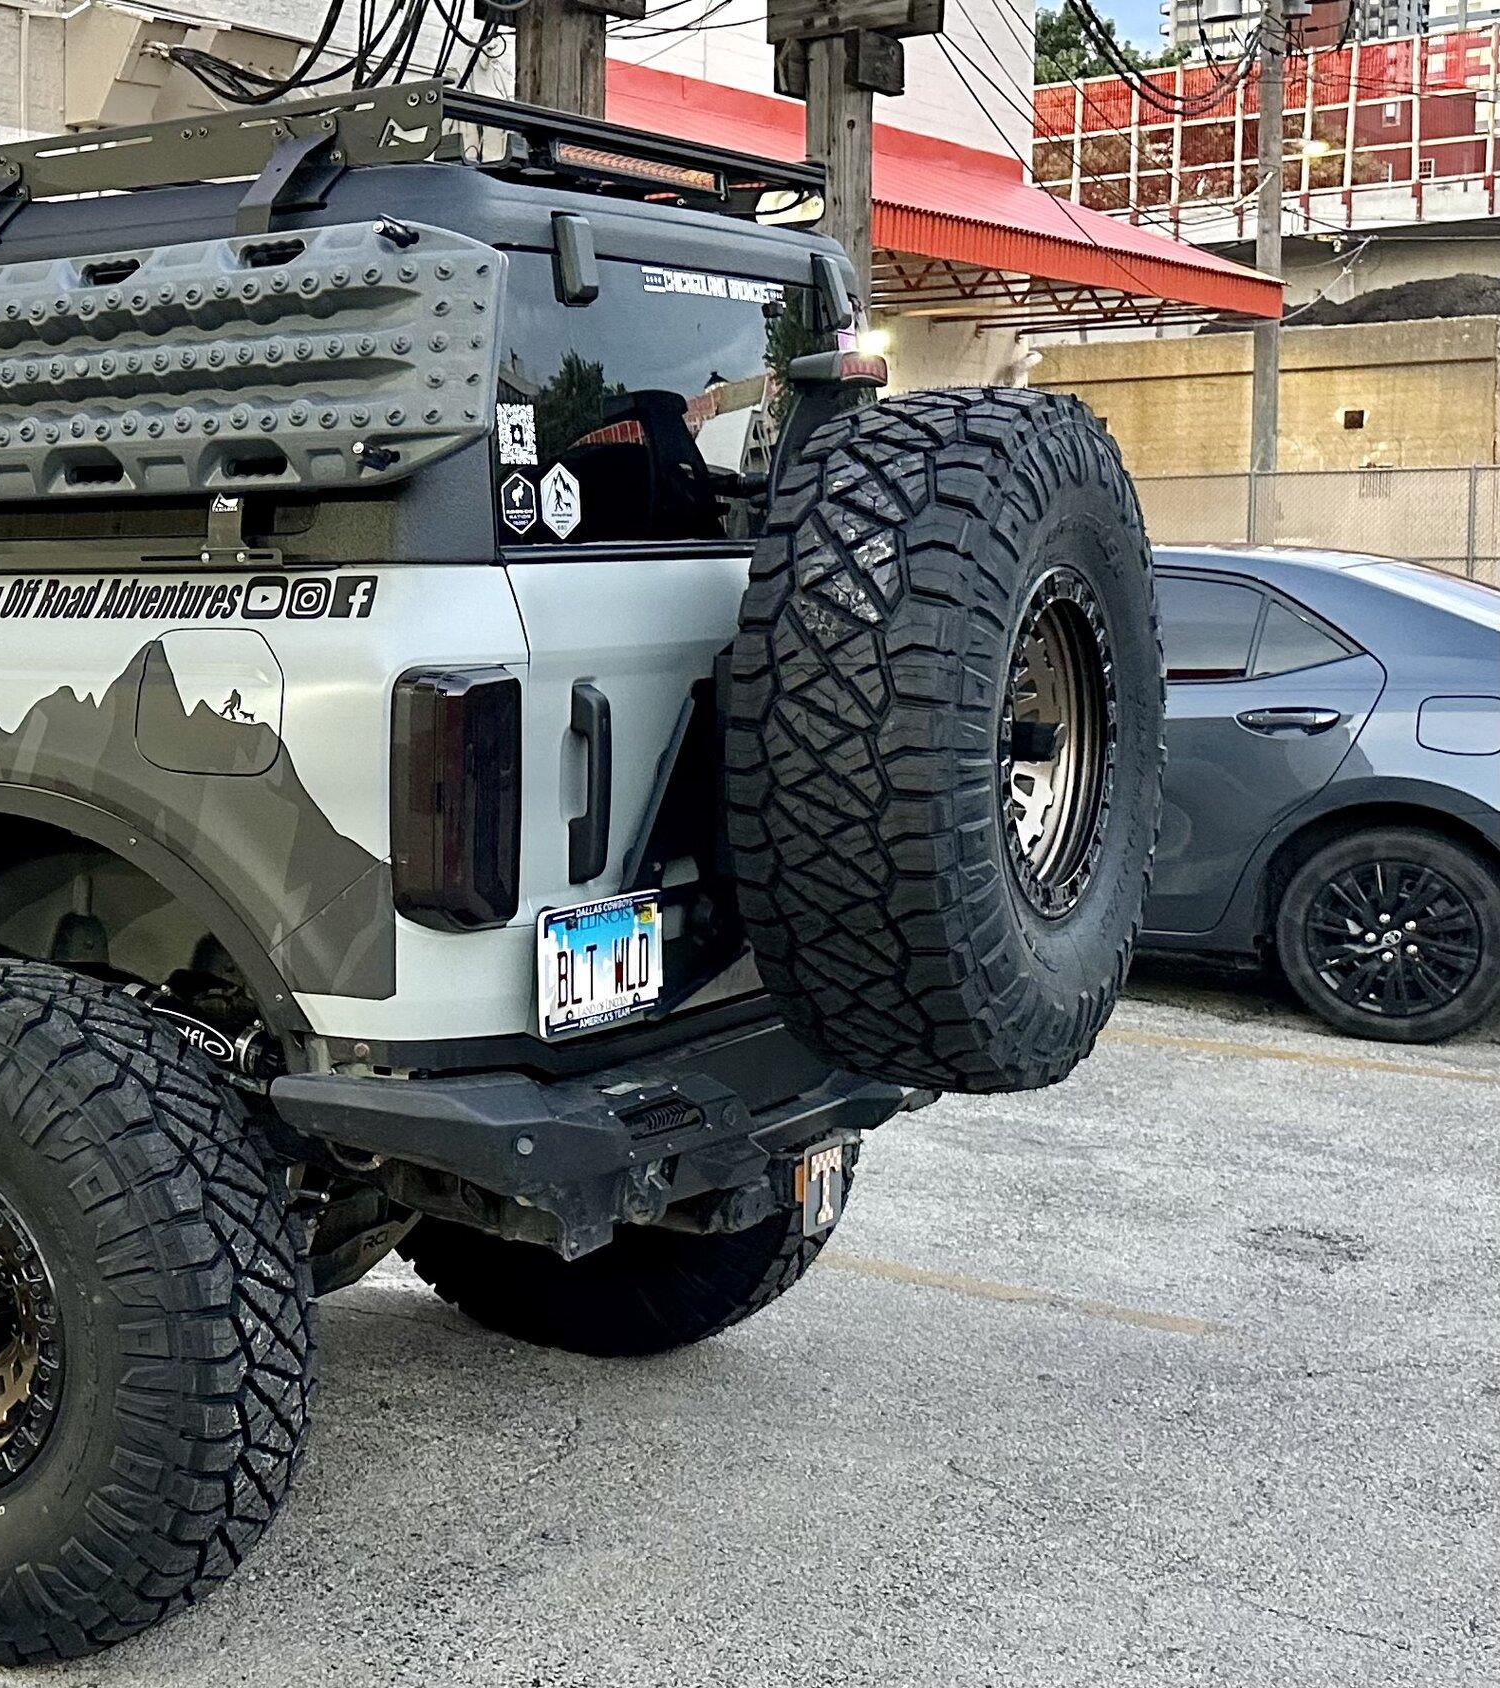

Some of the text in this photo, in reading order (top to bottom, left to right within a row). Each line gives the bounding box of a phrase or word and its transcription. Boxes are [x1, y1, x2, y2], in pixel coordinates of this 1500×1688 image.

[0, 578, 43, 619] Off
[33, 578, 104, 619] Road
[94, 578, 243, 619] Adventures
[575, 898, 634, 918] DALLAS COWBOYS
[575, 909, 632, 931] ILLINOIS
[557, 932, 649, 1009] BLT WLD
[579, 1006, 631, 1029] AMERICA'S TEAM
